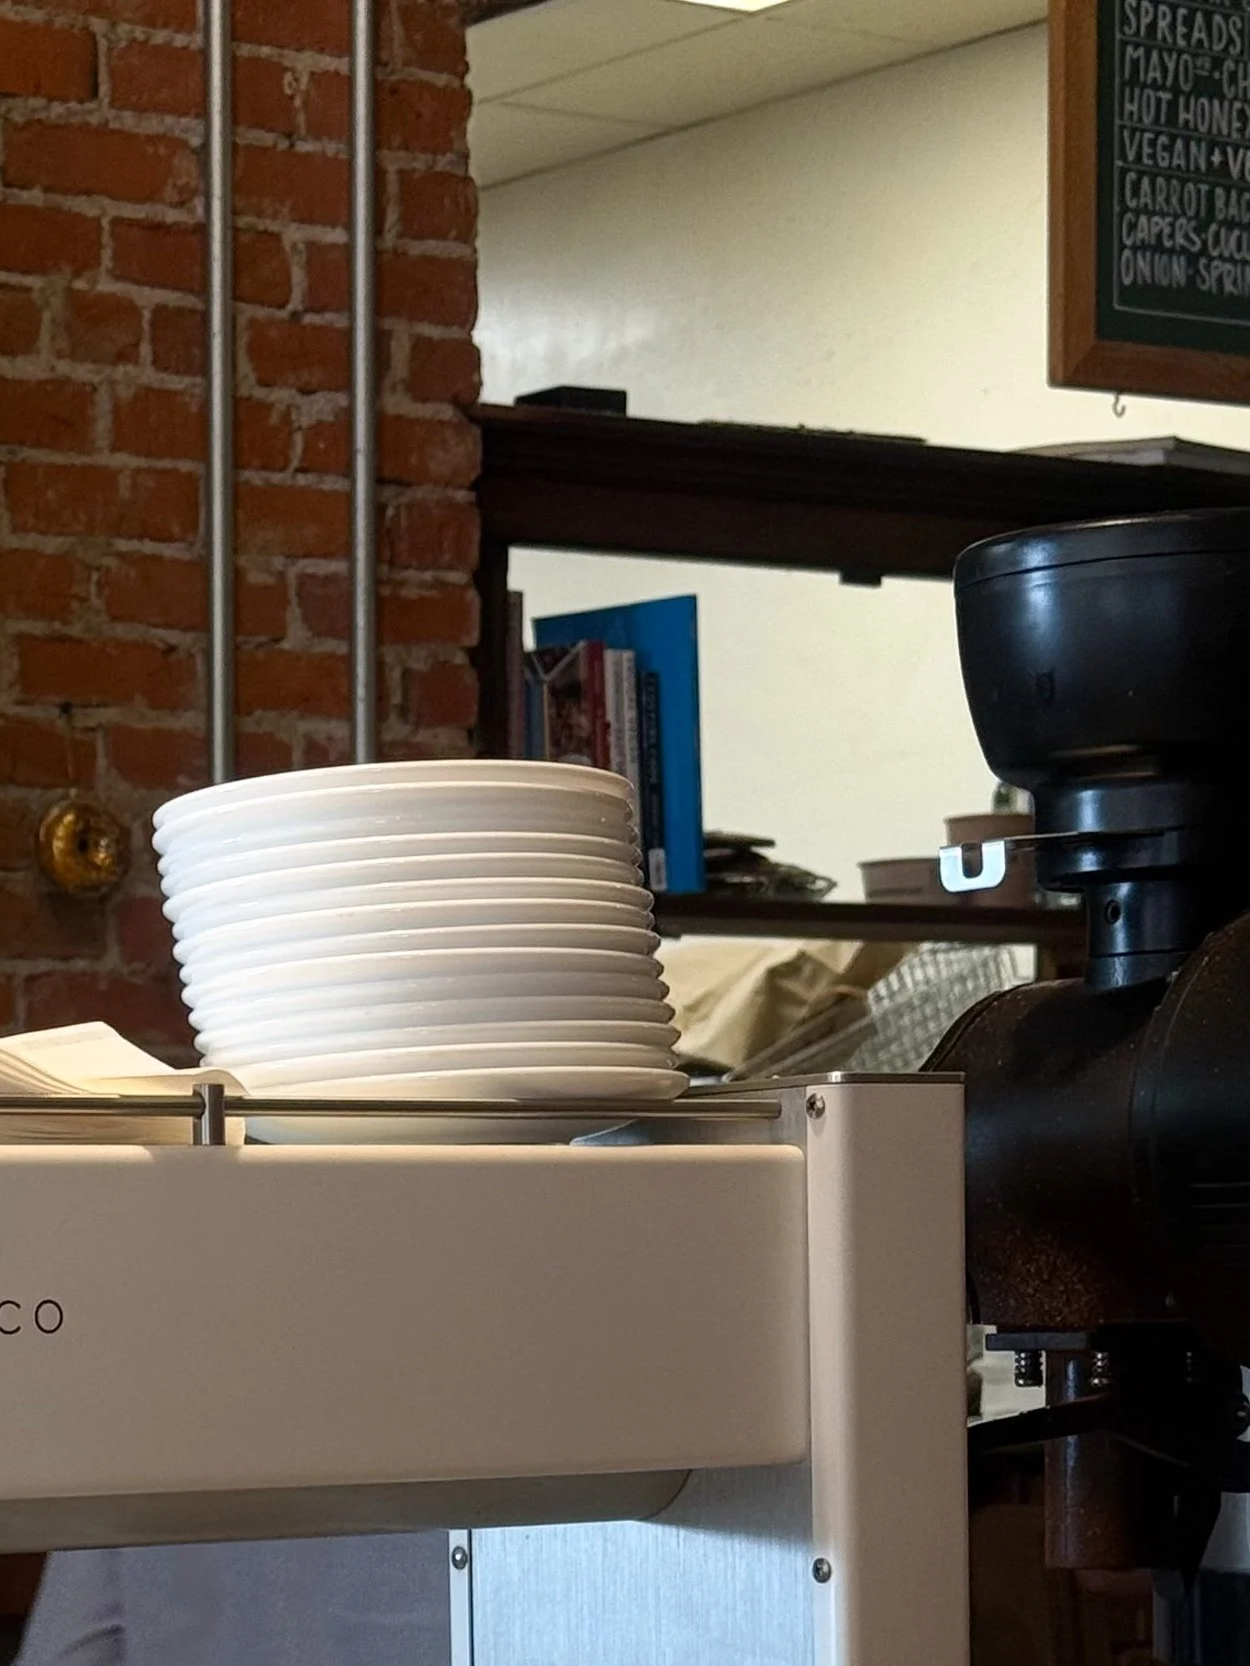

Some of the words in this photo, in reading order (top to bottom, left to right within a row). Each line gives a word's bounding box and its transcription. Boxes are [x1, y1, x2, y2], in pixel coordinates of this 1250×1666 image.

[1123, 0, 1242, 55] SPREADS
[1123, 87, 1172, 125] HOT
[1123, 128, 1207, 174] VEGAN
[1124, 171, 1209, 219] CARROT
[1121, 211, 1202, 252] CAPERS
[1121, 248, 1187, 286] ONION
